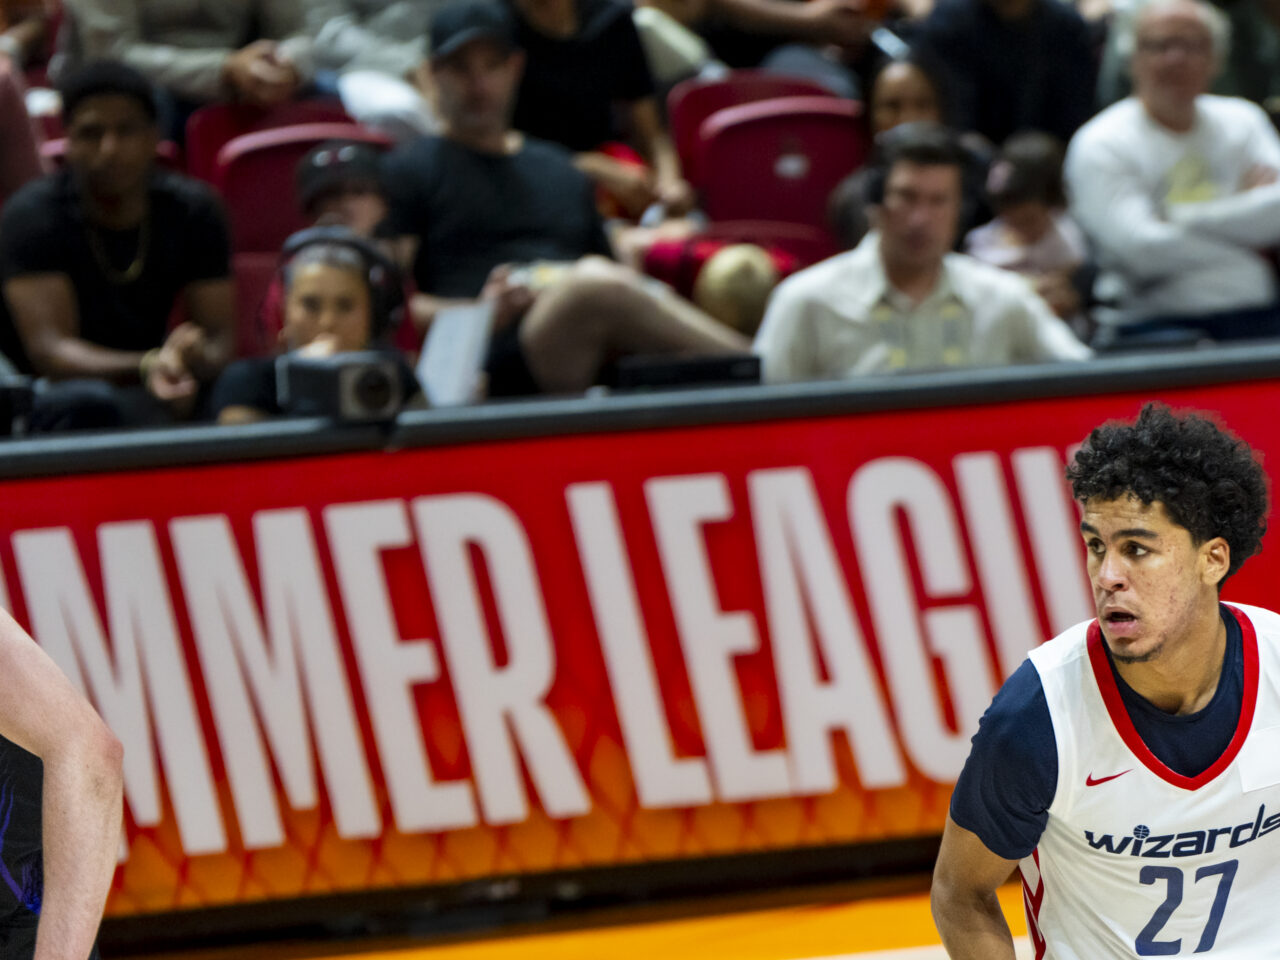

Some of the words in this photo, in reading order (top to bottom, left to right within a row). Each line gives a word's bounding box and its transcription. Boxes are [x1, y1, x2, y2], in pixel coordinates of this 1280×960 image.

[0, 491, 592, 863] MMER
[563, 441, 1097, 808] LEAGU
[1135, 859, 1239, 956] 27
